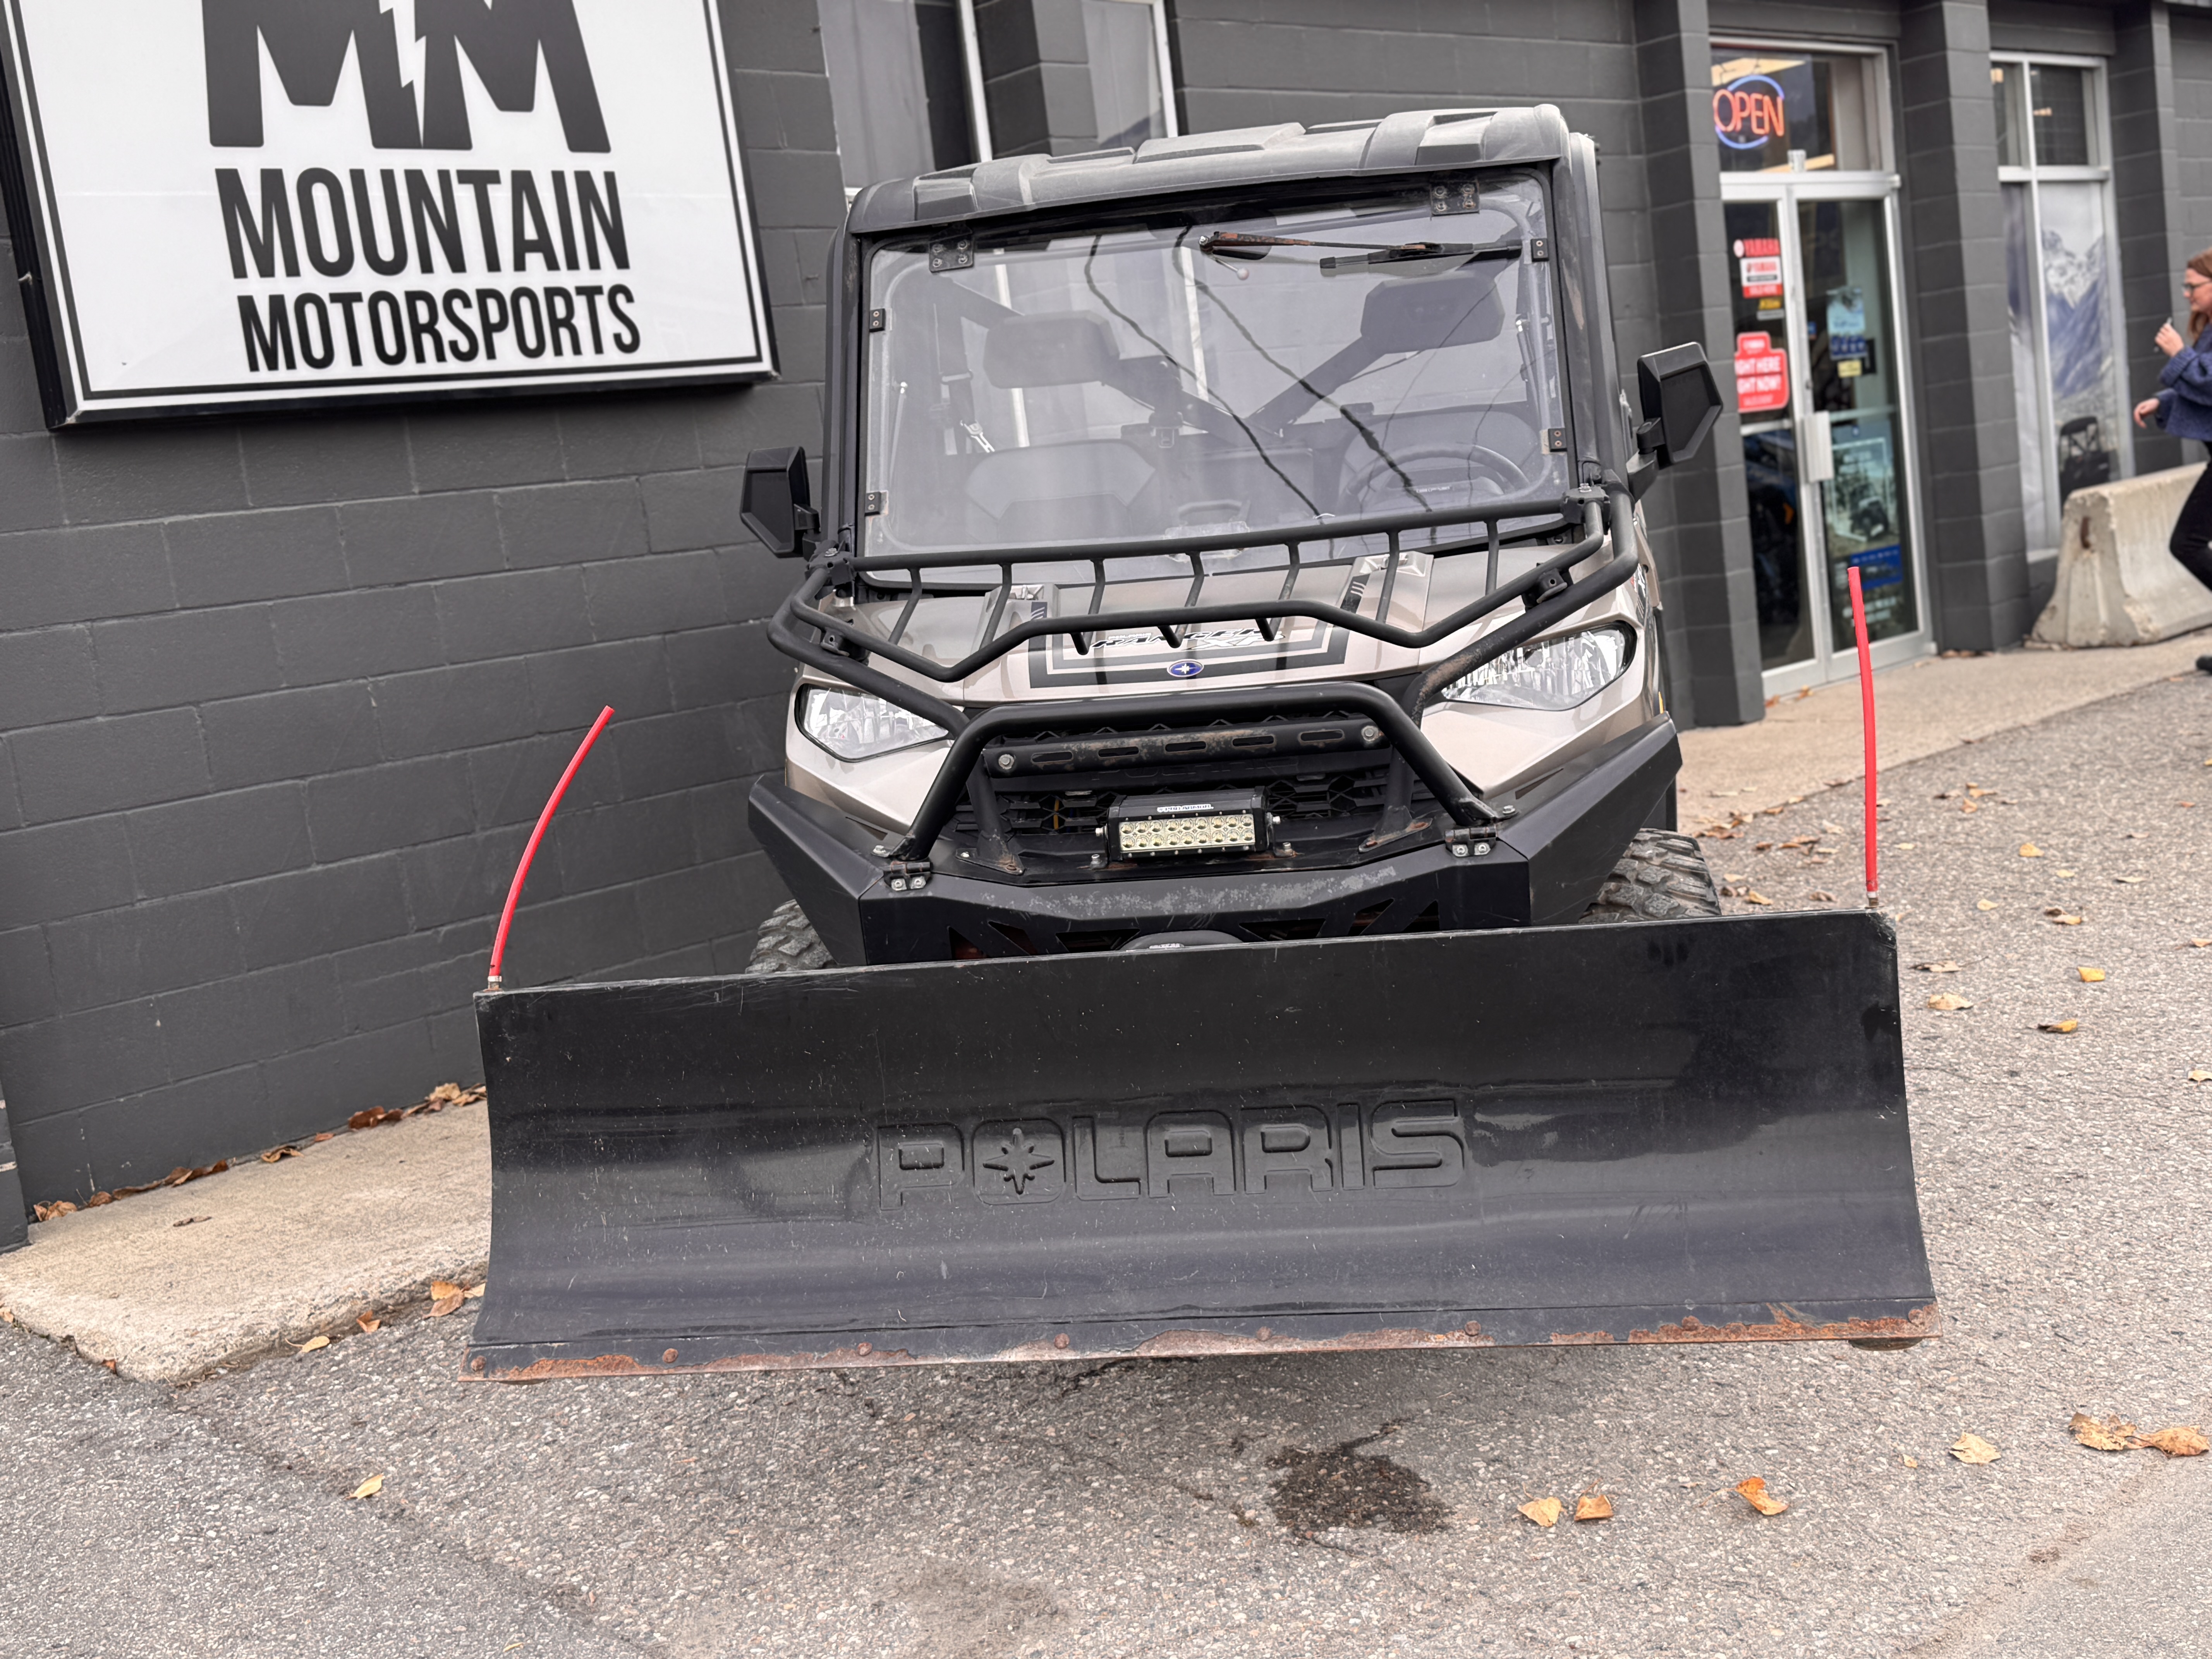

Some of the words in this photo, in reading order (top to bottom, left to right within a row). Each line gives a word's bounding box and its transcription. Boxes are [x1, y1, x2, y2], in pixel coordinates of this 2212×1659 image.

[1712, 89, 1784, 137] OPEN
[215, 167, 630, 279] MOUNTAIN
[1743, 238, 1780, 257] YAMAHA
[237, 284, 640, 372] MOTORSPORTS
[1757, 355, 1781, 373] HERE
[877, 1098, 1465, 1211] POLARIS
